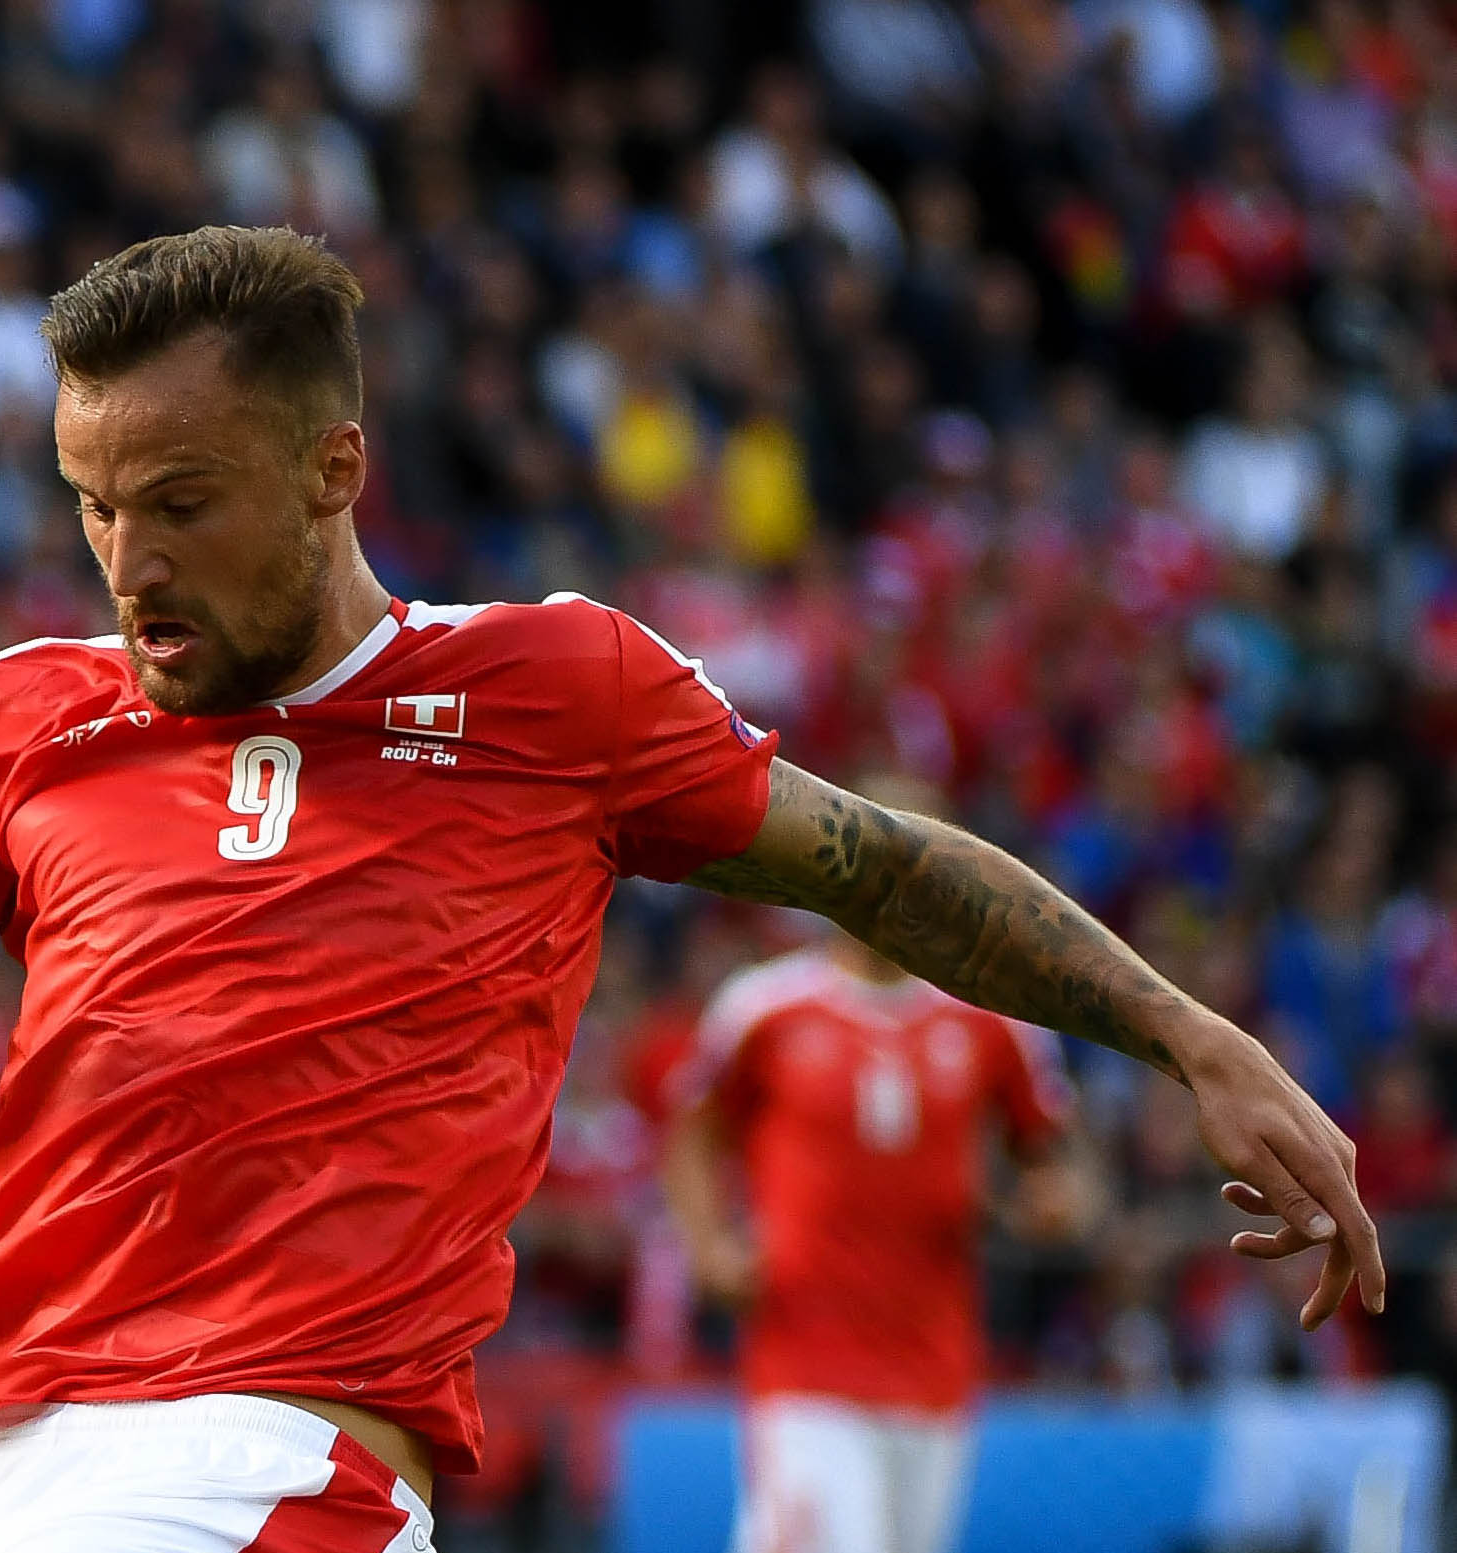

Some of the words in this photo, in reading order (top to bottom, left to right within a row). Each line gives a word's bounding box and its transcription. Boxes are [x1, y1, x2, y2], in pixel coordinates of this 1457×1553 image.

[380, 746, 419, 761] ROU
[431, 751, 458, 766] CH
[217, 736, 302, 861] 9
